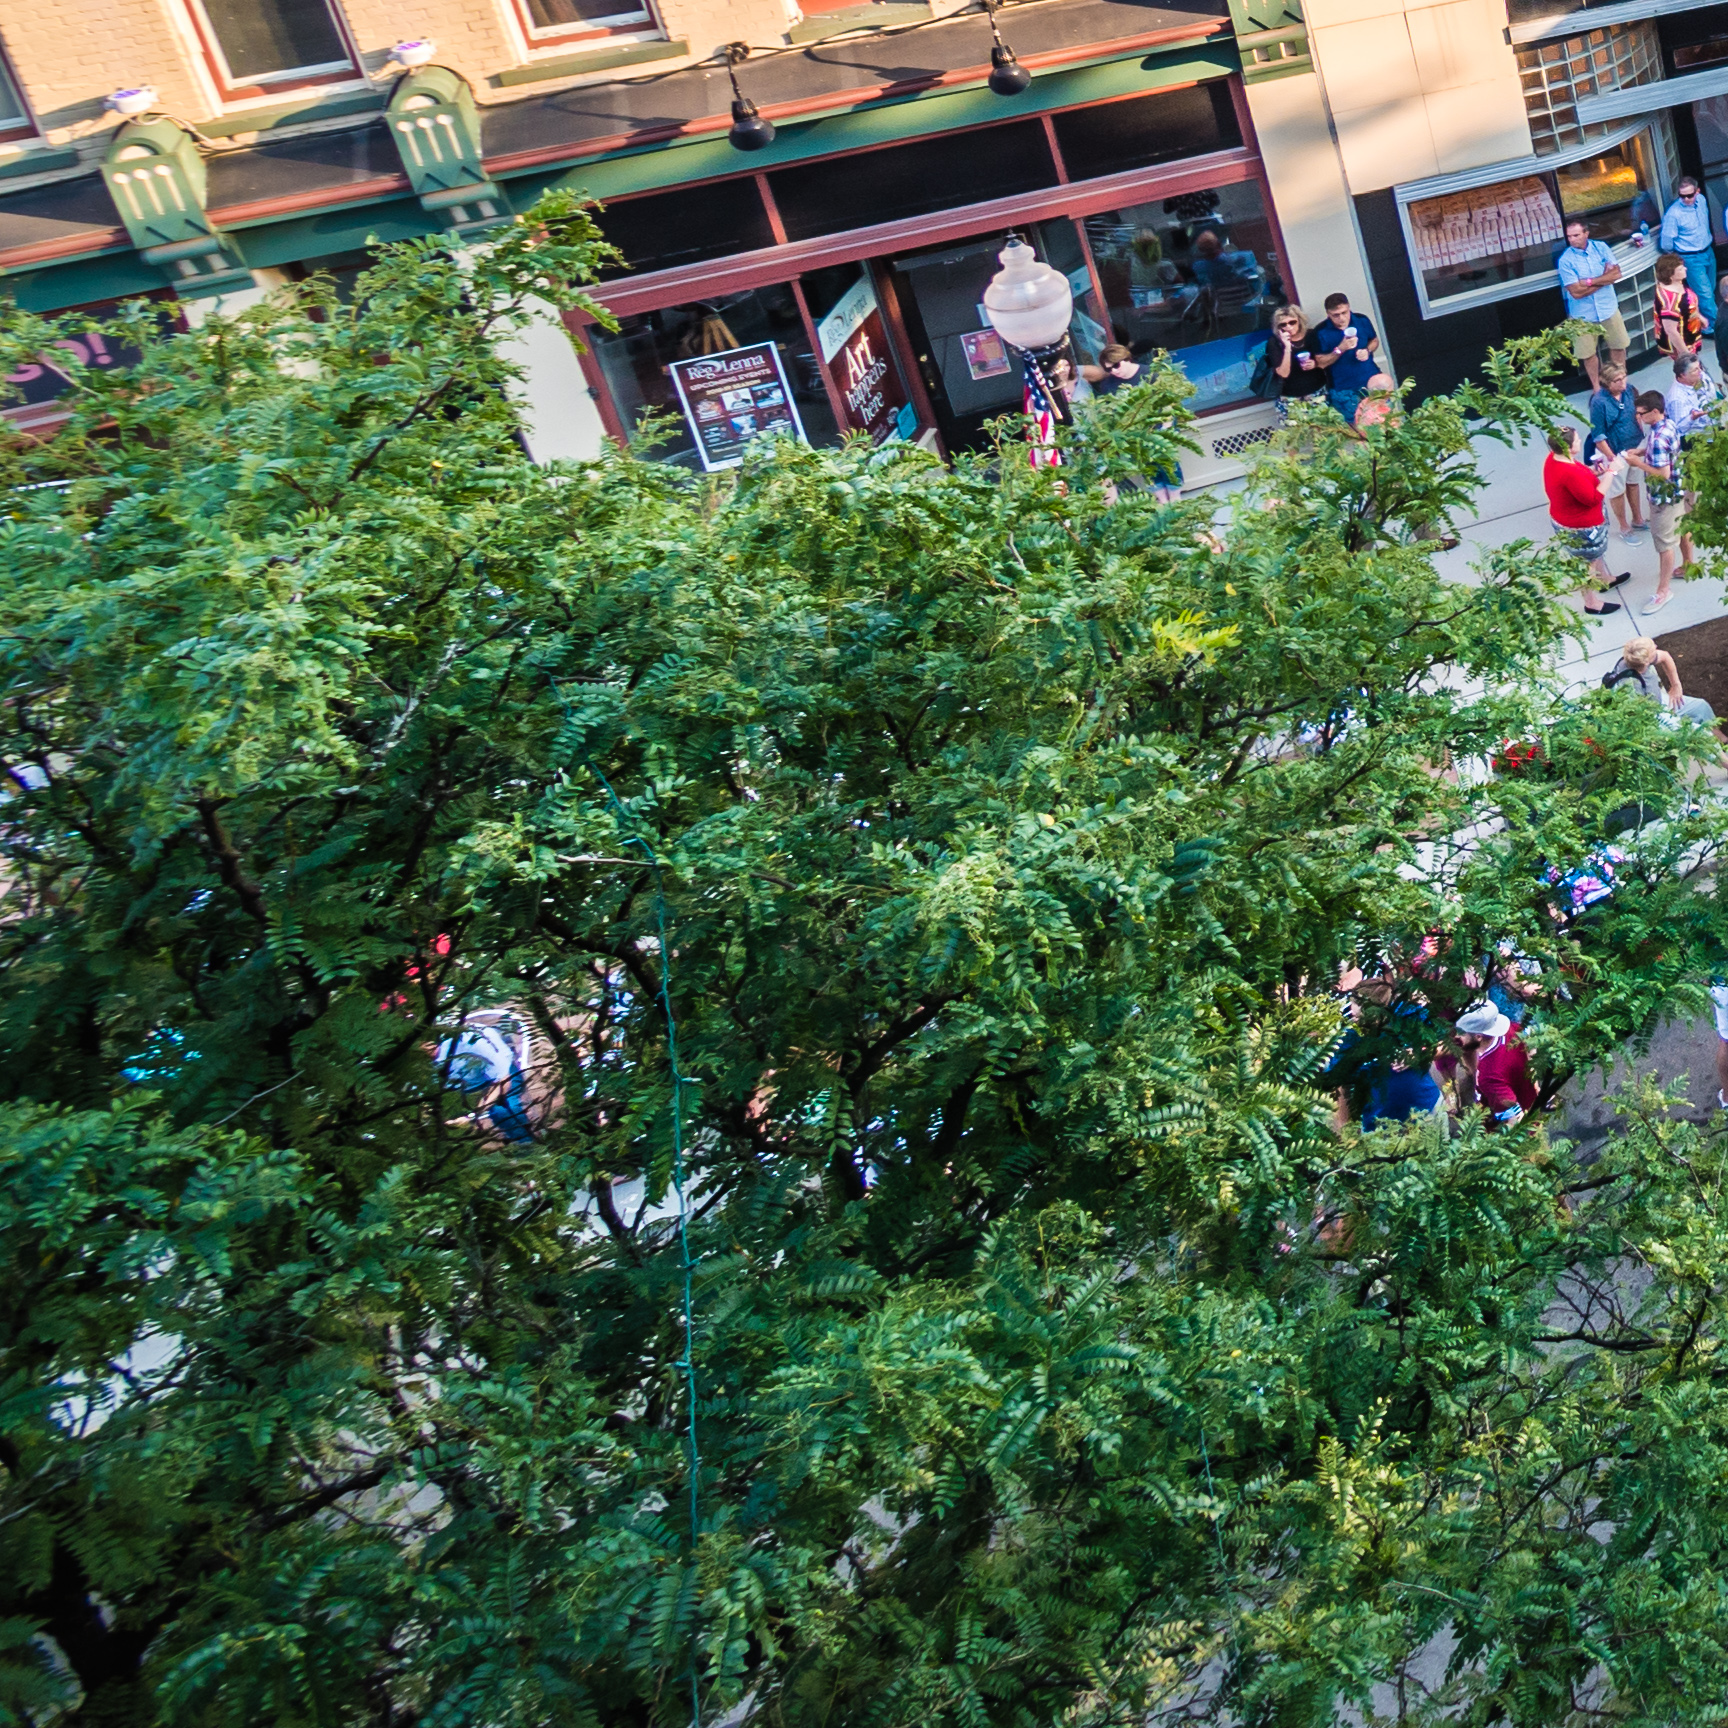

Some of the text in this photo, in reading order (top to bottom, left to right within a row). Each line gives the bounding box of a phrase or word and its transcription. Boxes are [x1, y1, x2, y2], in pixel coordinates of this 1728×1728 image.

[721, 355, 765, 373] Lenna
[845, 331, 875, 390] Art
[690, 376, 738, 391] UPCOMING
[845, 357, 887, 413] happens
[860, 391, 885, 425] here
